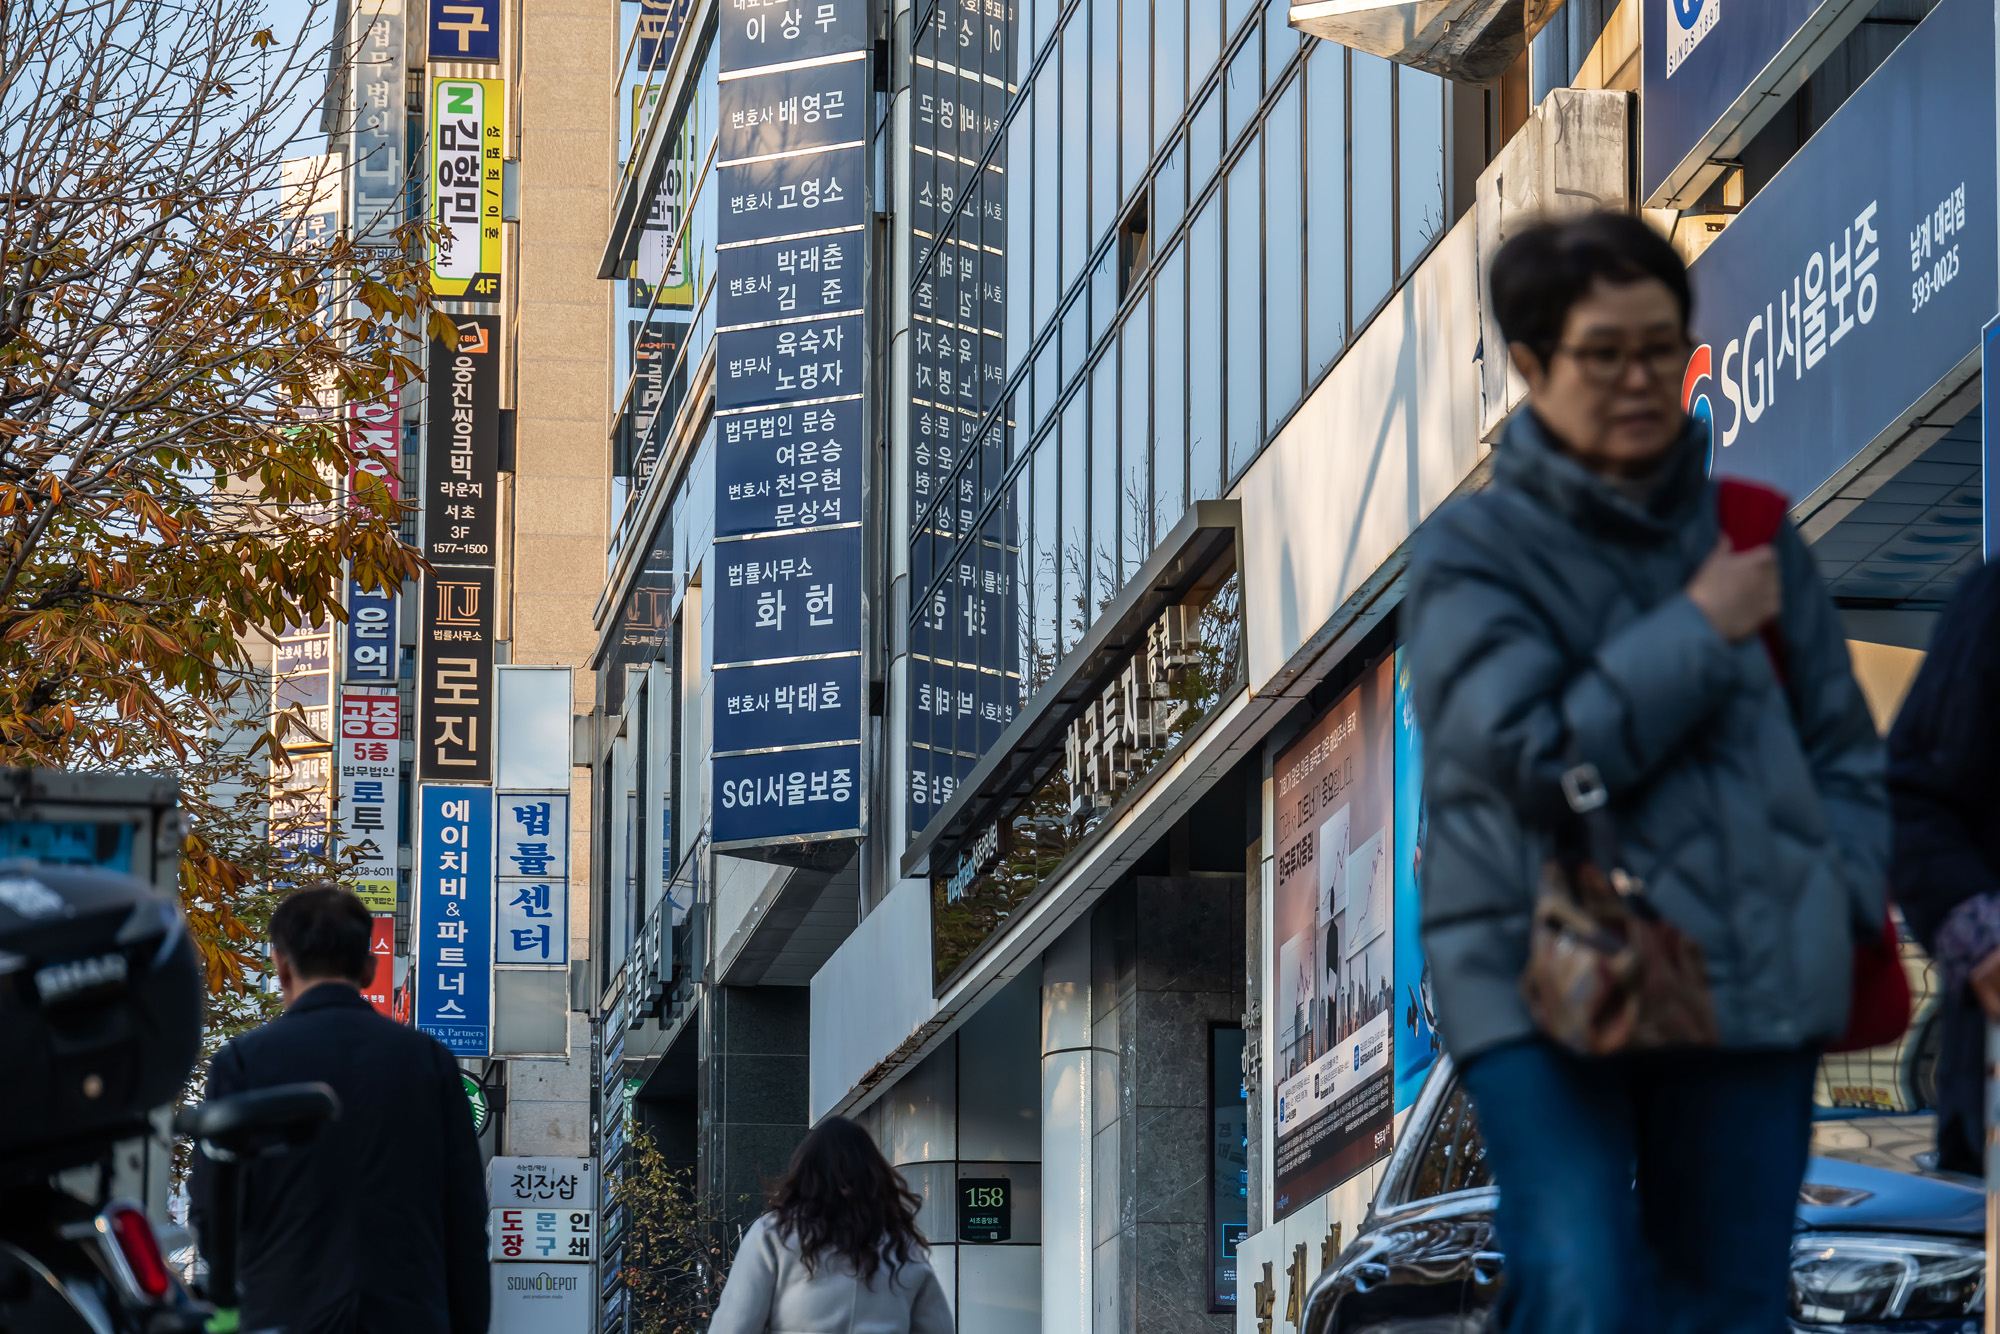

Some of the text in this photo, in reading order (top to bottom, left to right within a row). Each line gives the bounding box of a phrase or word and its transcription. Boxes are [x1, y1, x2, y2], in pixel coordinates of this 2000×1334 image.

[365, 20, 394, 137] 법무법인
[732, 90, 845, 129] 변호사 배영곤
[438, 119, 480, 225] 김형민
[731, 176, 844, 214] 변호사 고영소
[1910, 181, 1965, 272] 남계 대리점
[777, 243, 844, 277] 박래춘
[474, 278, 497, 294] 4F
[730, 274, 772, 297] 변호사
[1911, 244, 1960, 314] 593-0025
[776, 325, 844, 357] 육숙자
[1721, 200, 1881, 448] SGI서울보증
[730, 356, 843, 391] 법무사 노명자
[450, 356, 476, 481] 웅진씽크빅
[725, 408, 837, 443] 법무법인 문승
[776, 438, 843, 467] 여운승
[440, 482, 483, 498] 라운지
[728, 467, 842, 501] 변호사 천우현
[445, 504, 476, 519] 서초
[774, 498, 842, 527] 문상석
[432, 543, 488, 554] 1577-1500
[450, 526, 470, 539] 3F
[728, 557, 813, 586] 법률사무소
[433, 630, 482, 642] 법률사무소
[434, 657, 480, 766] 로진
[727, 681, 841, 715] 변호사 박태호
[343, 700, 397, 735] 공증
[353, 742, 389, 761] 5층
[343, 765, 395, 778] 법무법인
[722, 768, 853, 809] SGI서울보증
[351, 781, 385, 860] 로투스
[437, 1028, 445, 1036] &
[448, 1028, 485, 1037] Partners
[510, 1174, 578, 1199] 진진샵
[966, 1187, 1004, 1208] 158
[501, 1211, 524, 1257] 도장
[536, 1212, 556, 1257] 문구
[568, 1212, 589, 1257] 인쇄
[507, 1277, 578, 1290] SOUND DEPOT
